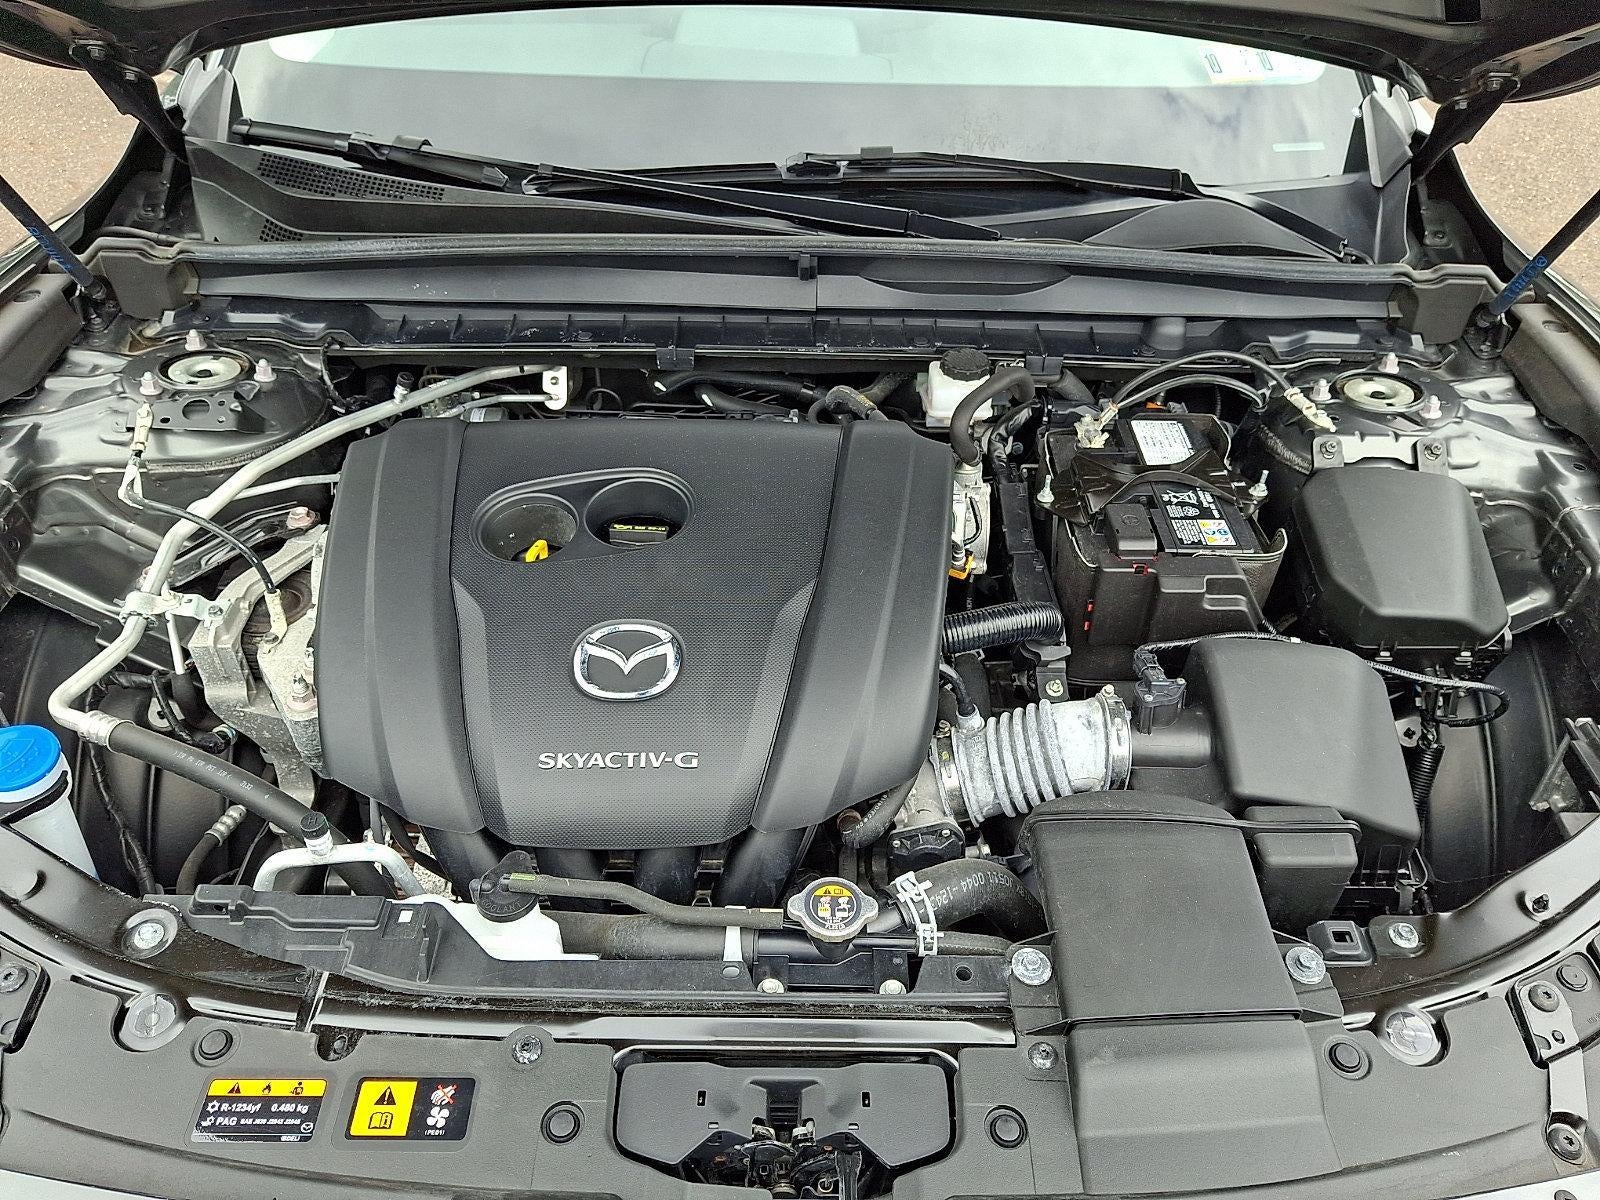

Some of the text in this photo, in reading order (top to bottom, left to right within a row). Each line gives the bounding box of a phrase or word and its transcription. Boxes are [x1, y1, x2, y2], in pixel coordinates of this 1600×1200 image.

[538, 752, 699, 769] SKYACTIV-G
[220, 1103, 262, 1114] R-1234yf
[296, 1103, 309, 1114] kg
[216, 1117, 238, 1126] PAG
